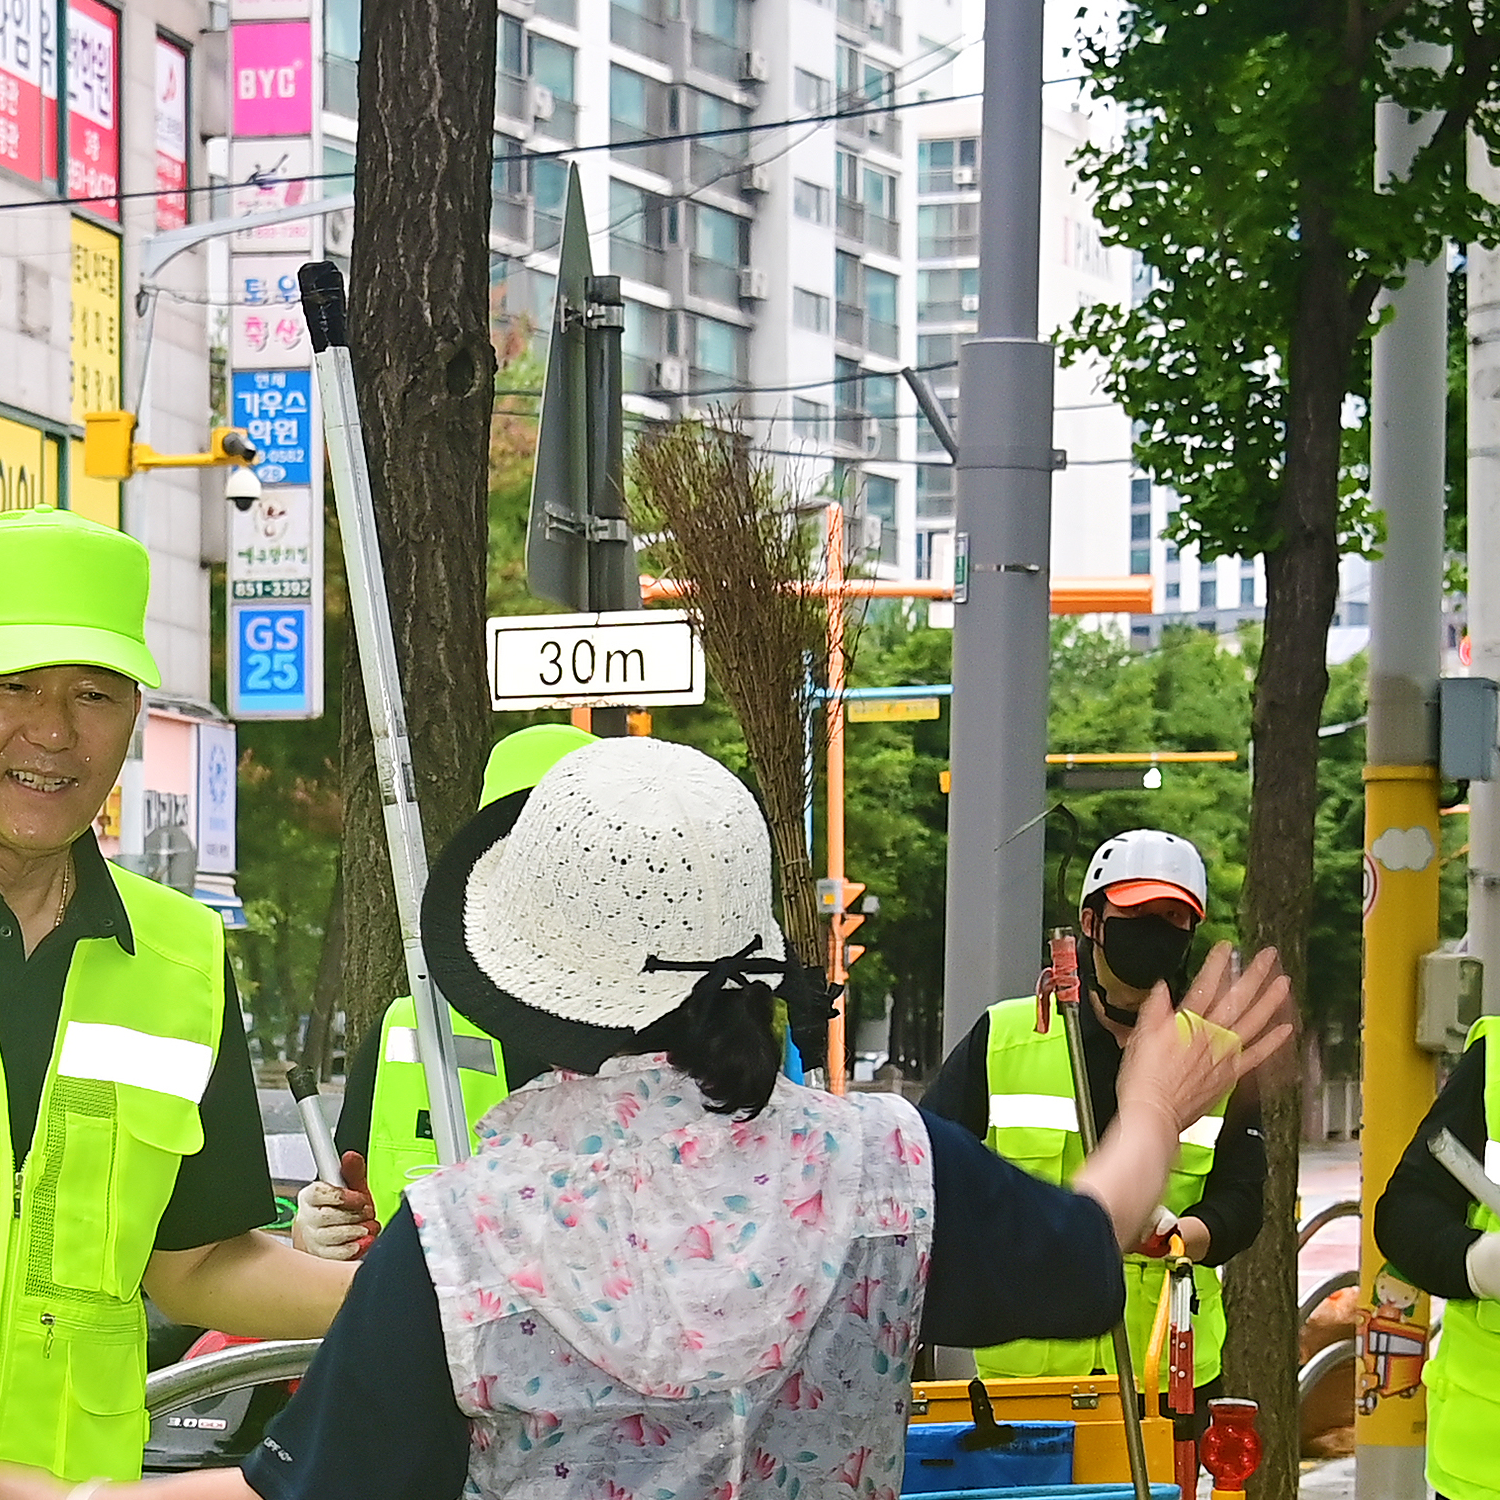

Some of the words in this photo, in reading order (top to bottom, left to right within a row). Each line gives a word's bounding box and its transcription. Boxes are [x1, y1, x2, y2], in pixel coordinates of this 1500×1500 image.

[240, 68, 297, 100] BYC
[236, 390, 308, 419] 가우스
[235, 582, 311, 597] 851-3392
[244, 616, 299, 652] GS
[247, 653, 299, 691] 25
[538, 639, 646, 687] 30m
